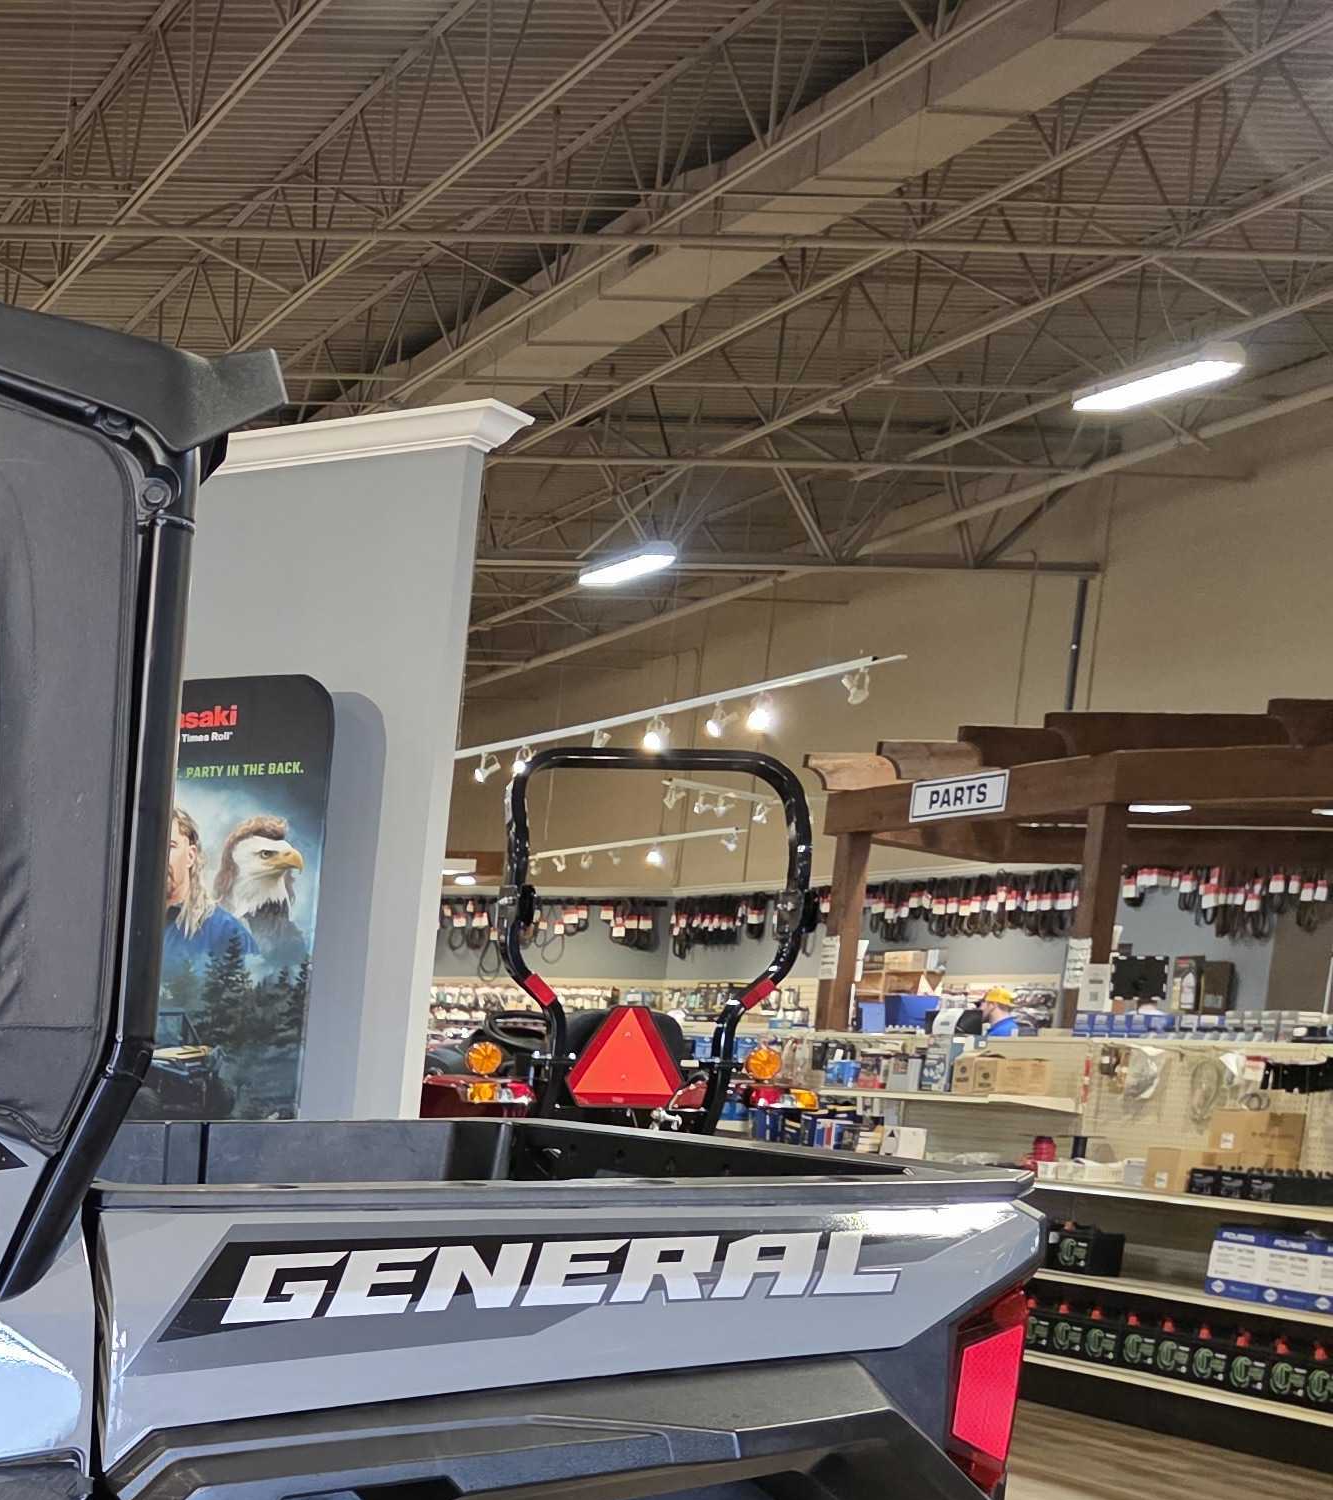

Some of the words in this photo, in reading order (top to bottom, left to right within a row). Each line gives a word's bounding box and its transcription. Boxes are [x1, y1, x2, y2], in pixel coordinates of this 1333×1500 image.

[186, 765, 224, 779] PARTY
[227, 764, 240, 777] IN
[243, 763, 265, 776] THE
[267, 761, 305, 775] BACK.
[928, 783, 988, 810] PARTS
[221, 1232, 902, 1325] GENERAL
